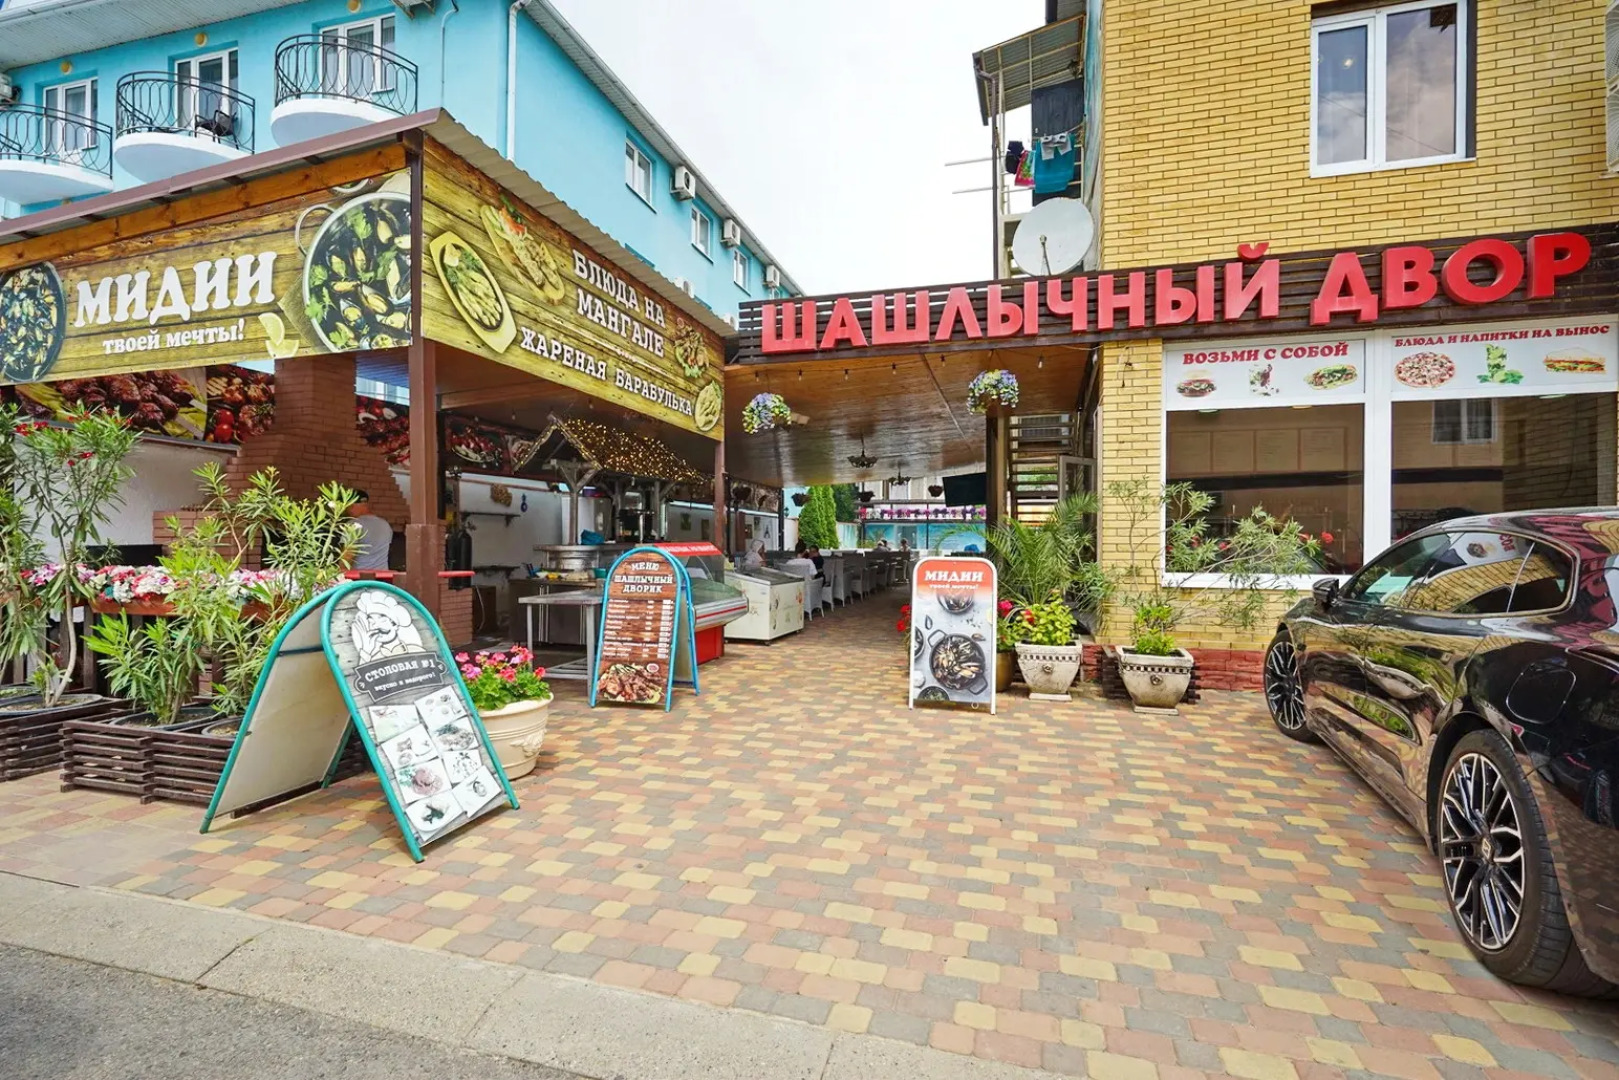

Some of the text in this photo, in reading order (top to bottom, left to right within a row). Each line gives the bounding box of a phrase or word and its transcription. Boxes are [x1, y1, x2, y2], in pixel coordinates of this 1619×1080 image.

[73, 251, 278, 329] МИДИИ
[572, 249, 666, 328] БЛЮДА НА
[761, 231, 1592, 354] ШАШЛЫЧНЫЙ ДВОР
[576, 288, 666, 358] МАНГАЛЕ
[103, 318, 245, 355] твоей мечты!
[1394, 324, 1611, 348] БЛЮДА И НАПИТКИ НА ВЫНОС
[1182, 340, 1349, 365] ВОЗЬМИ С СОБОЙ
[520, 326, 693, 416] ЖАРЕНАЯ БАРАБУЛЬКА
[614, 573, 673, 584] ШАШЛЫЧНЫЙ
[631, 561, 660, 571] МЕНЮ
[924, 570, 984, 582] МИДИИ
[622, 584, 662, 593] ДВОРИК
[365, 660, 419, 682] СТОЛОВАЯ
